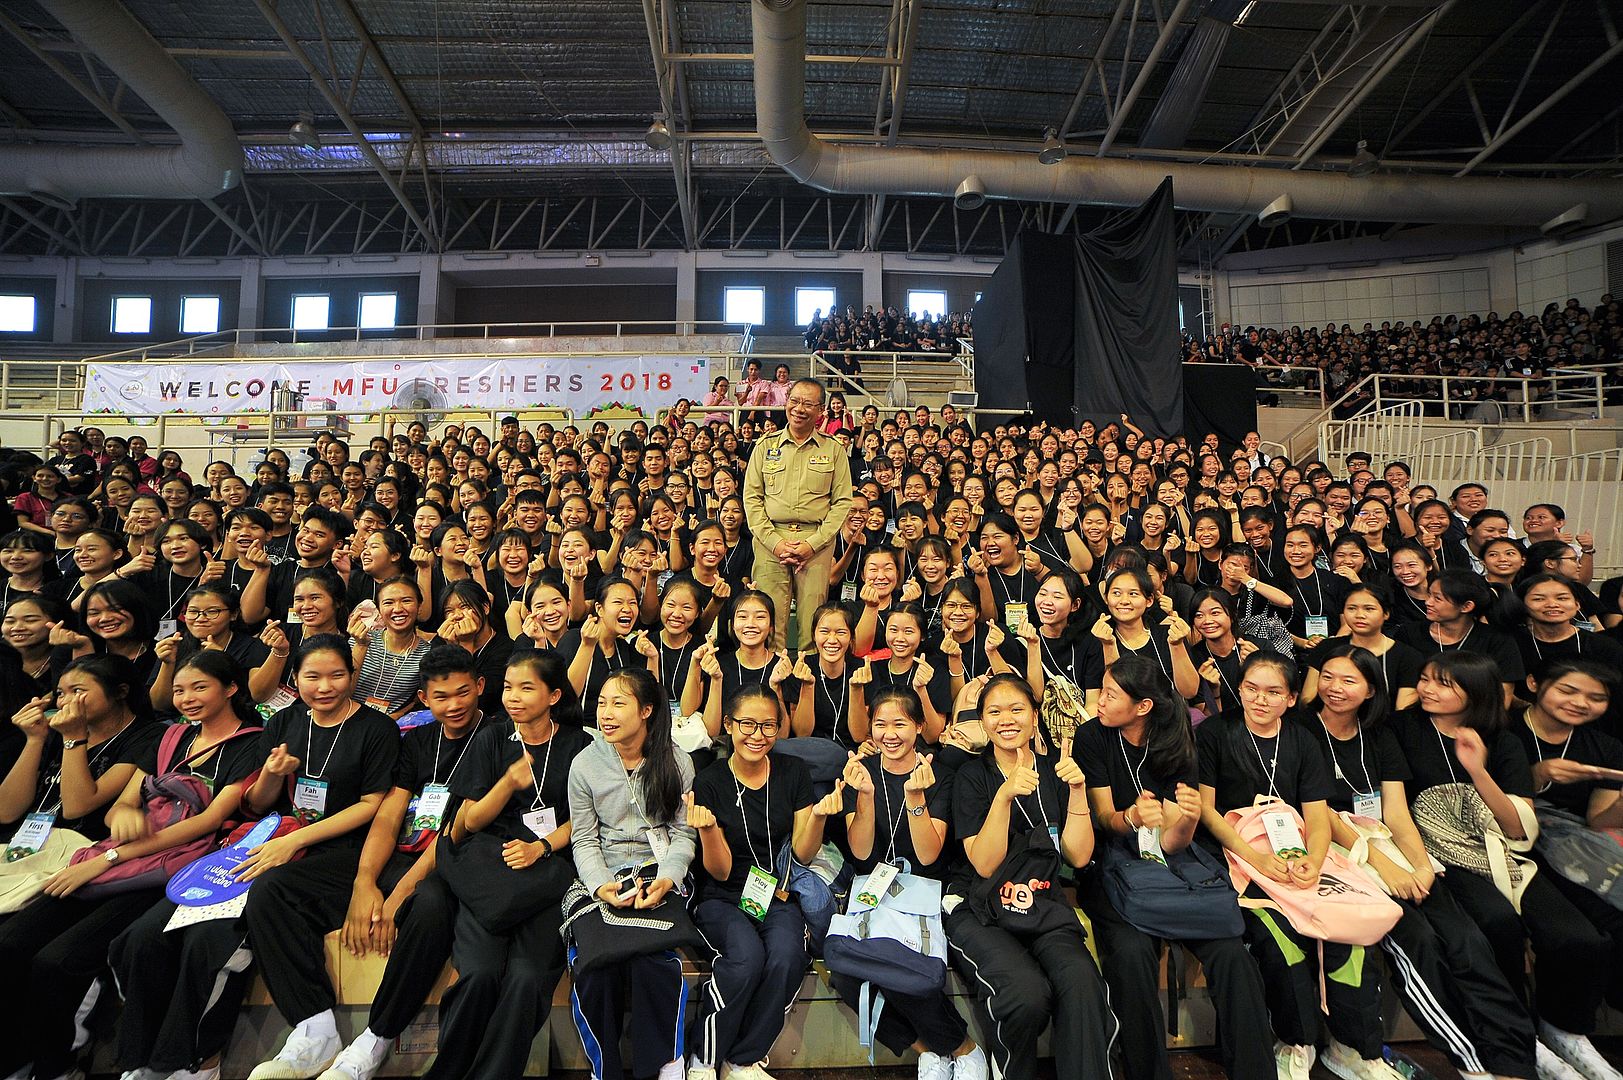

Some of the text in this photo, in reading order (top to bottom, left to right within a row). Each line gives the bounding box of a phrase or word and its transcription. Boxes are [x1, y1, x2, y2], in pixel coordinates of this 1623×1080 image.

[333, 377, 398, 395] MFU
[413, 374, 583, 395] FRESHERS
[600, 371, 672, 392] 2018
[304, 786, 317, 795] Fah
[1360, 800, 1374, 808] Milk
[28, 821, 44, 830] First
[1010, 906, 1028, 915] BRAIN
